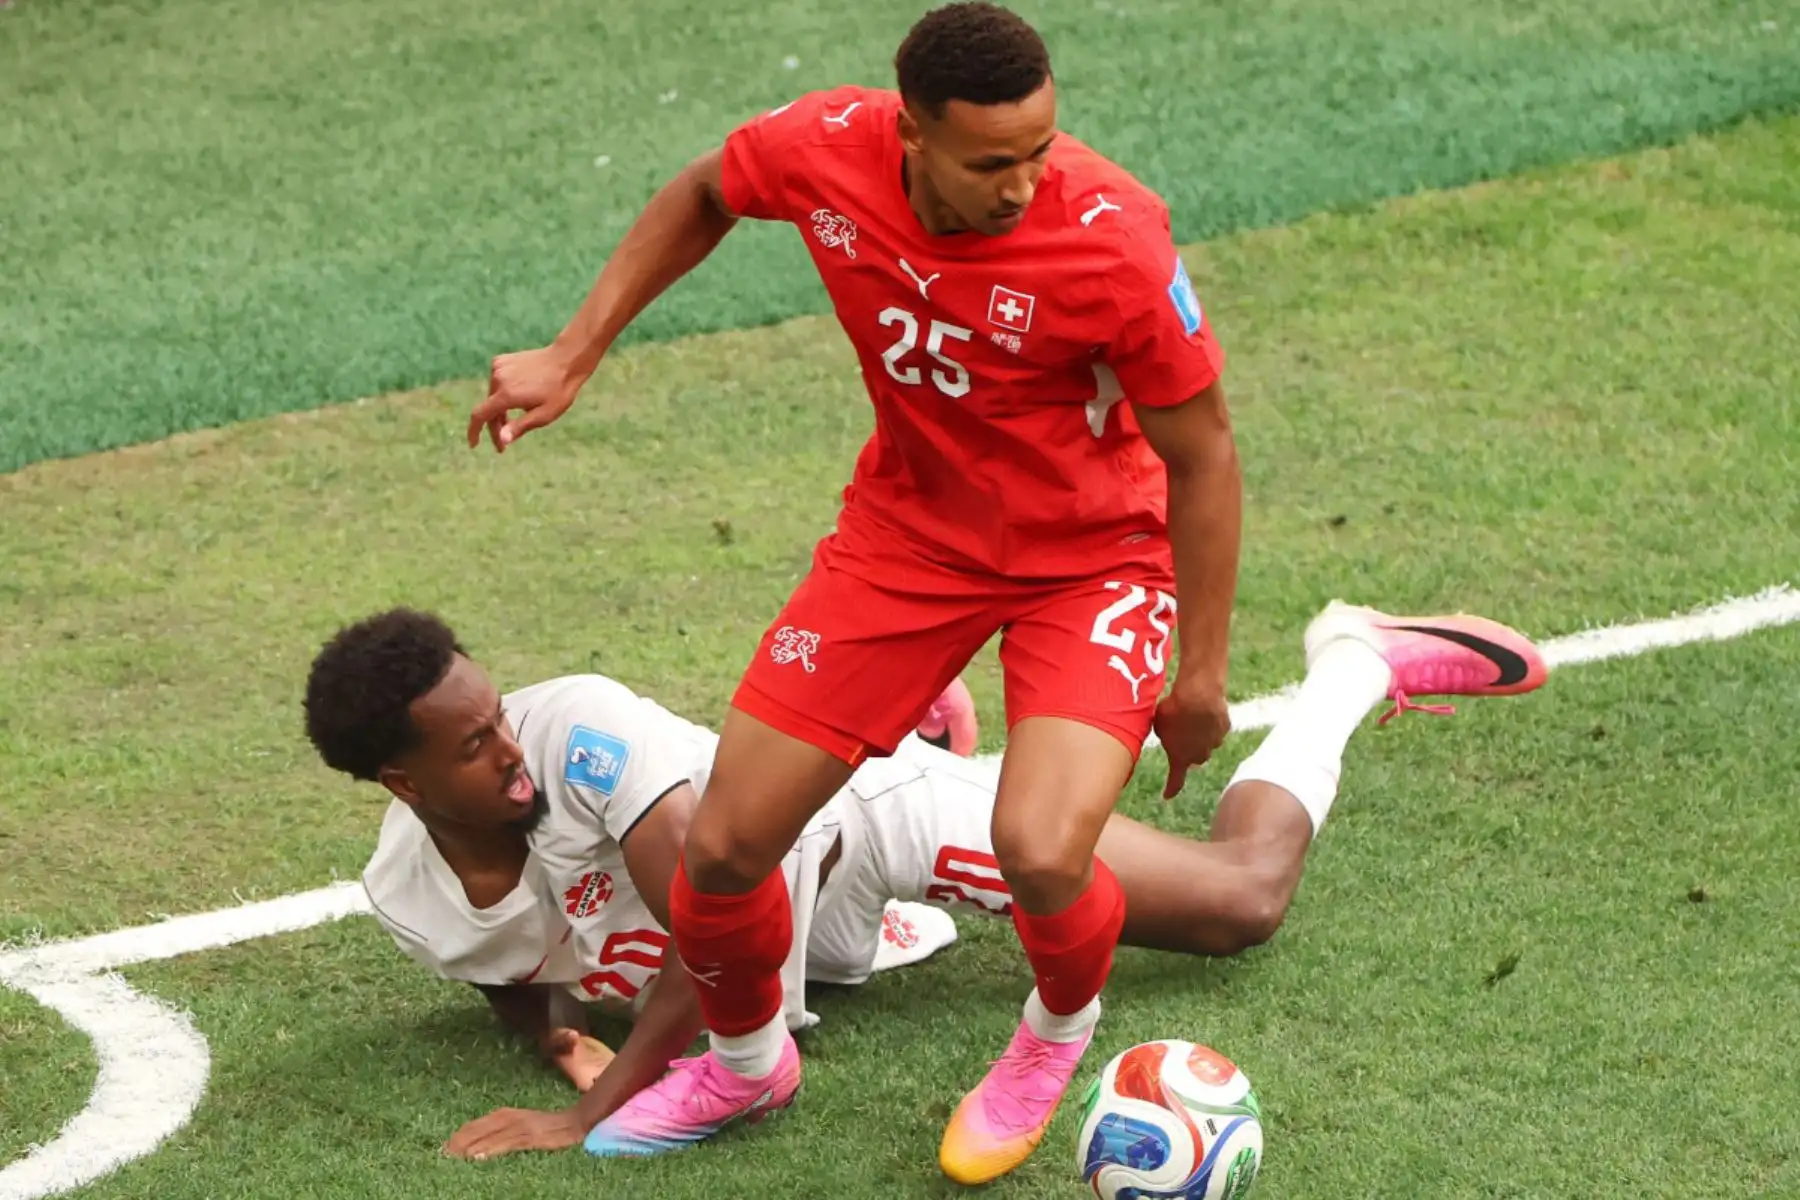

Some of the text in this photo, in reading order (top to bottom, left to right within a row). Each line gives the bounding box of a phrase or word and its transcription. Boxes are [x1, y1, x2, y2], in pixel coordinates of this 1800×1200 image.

[879, 306, 973, 397] 25
[1089, 581, 1177, 675] 25
[576, 871, 603, 918] CANADA
[579, 929, 670, 999] 20
